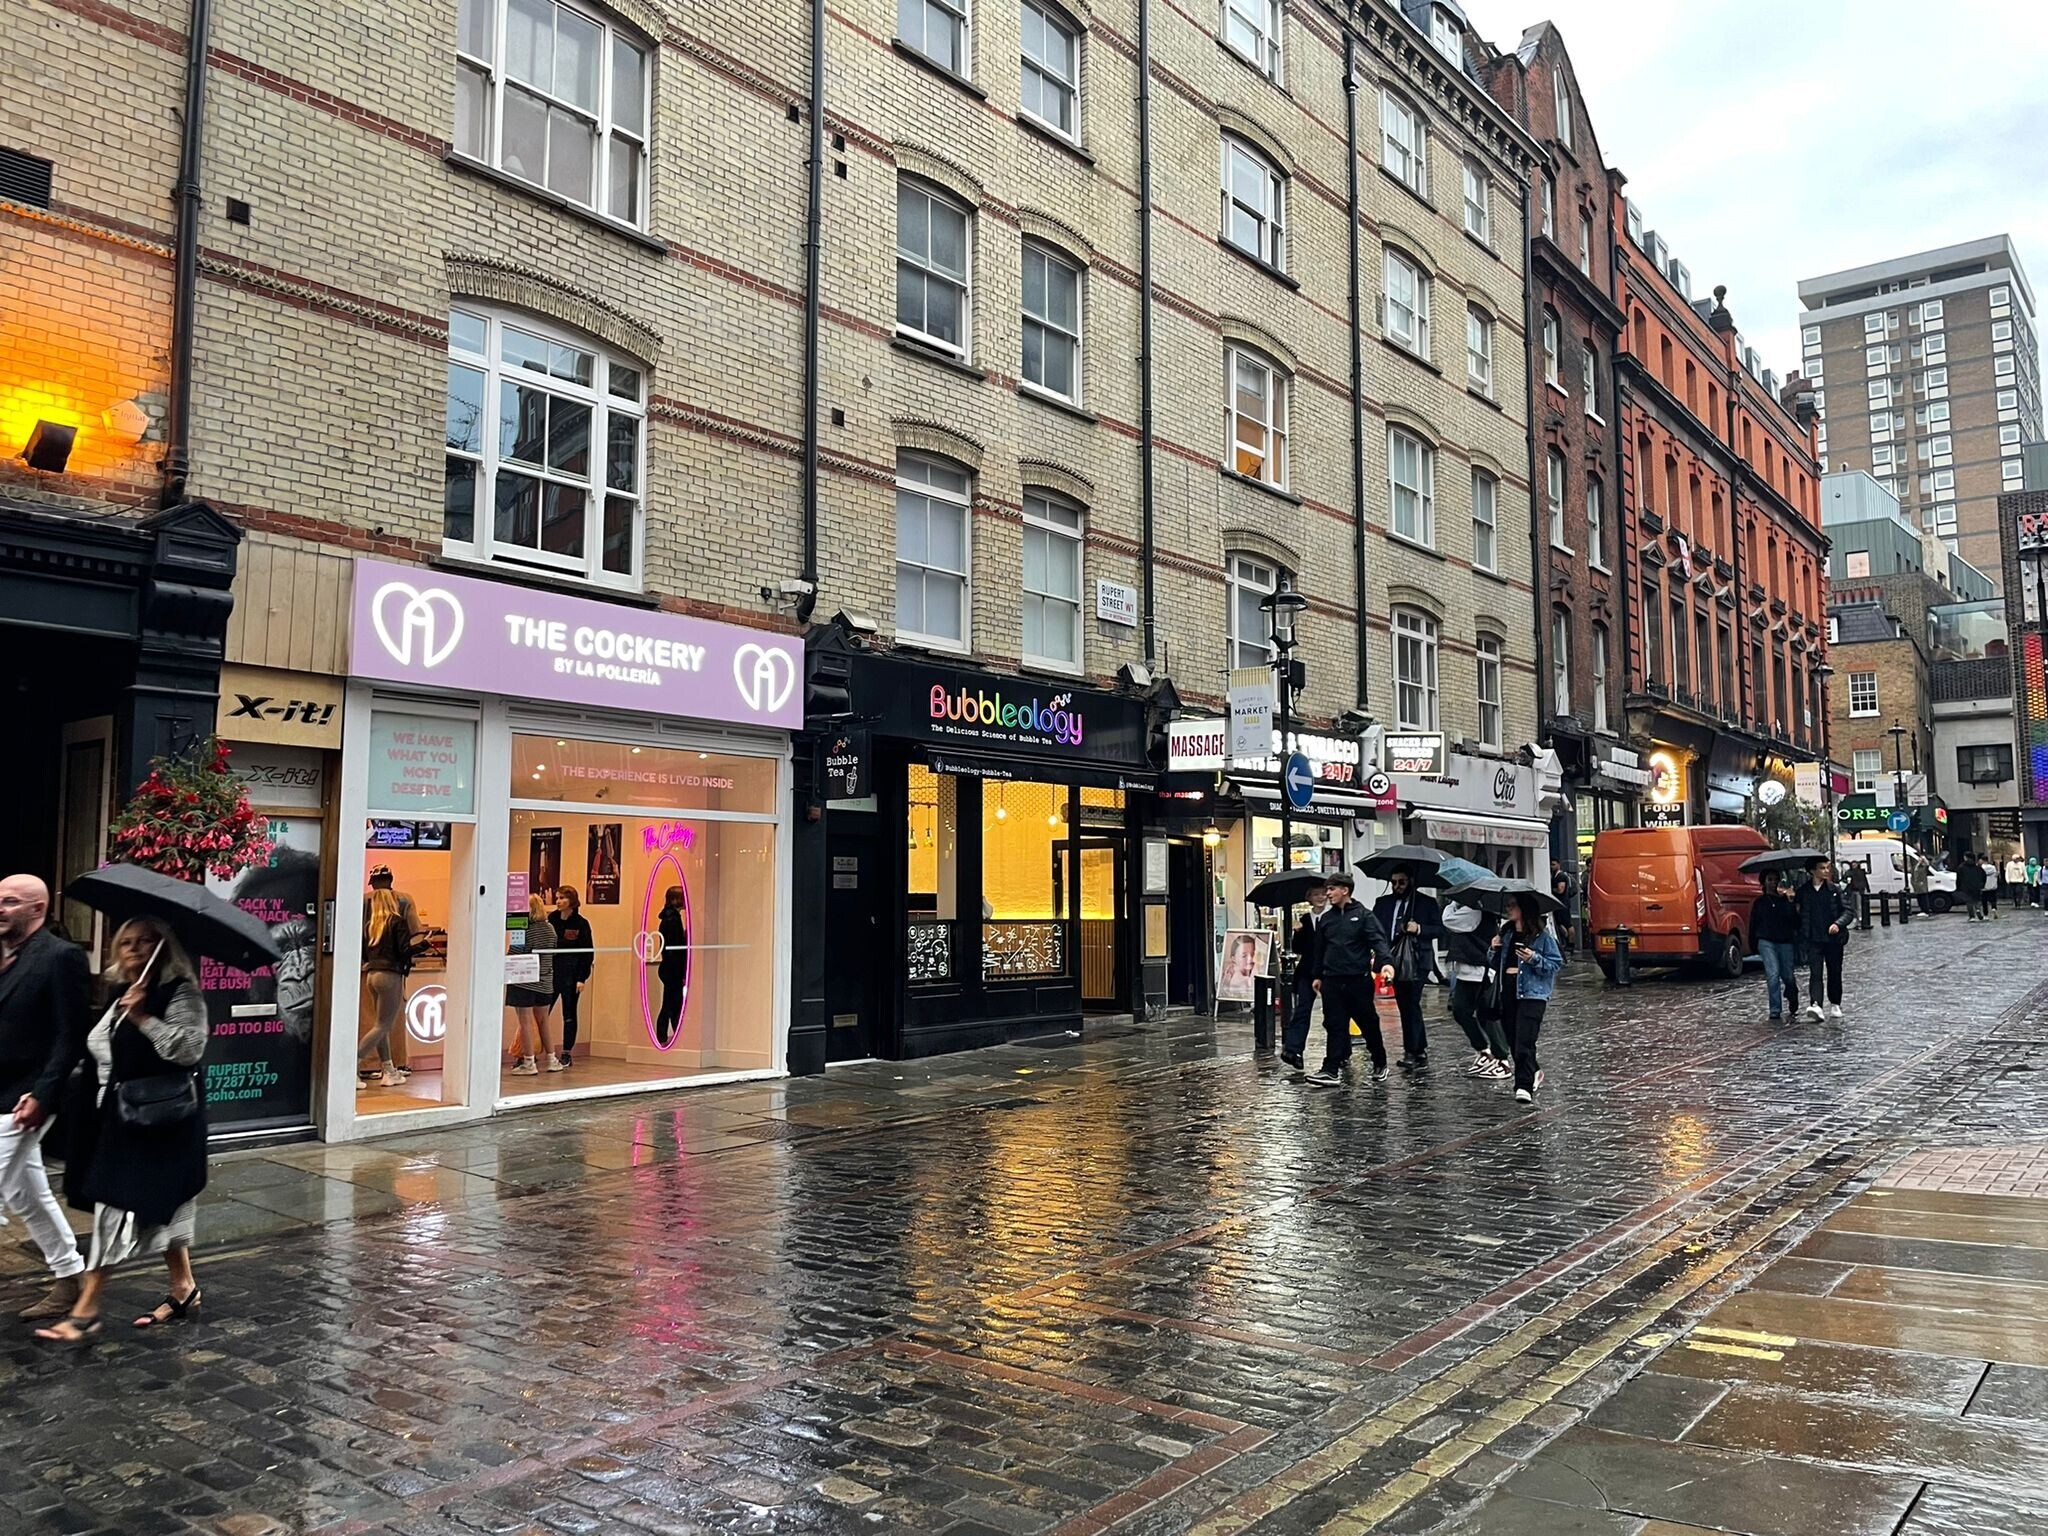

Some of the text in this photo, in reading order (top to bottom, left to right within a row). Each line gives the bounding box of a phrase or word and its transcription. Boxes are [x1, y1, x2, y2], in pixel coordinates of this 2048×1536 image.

[1102, 584, 1124, 599] RUPERT
[1101, 596, 1123, 610] STREET
[504, 614, 706, 672] THE COCKERY
[554, 657, 662, 686] BY LA POLLERÍA
[225, 694, 337, 726] X-it!
[930, 684, 1083, 745] Bubbleology
[1234, 705, 1269, 716] MARKET
[393, 732, 454, 748] WE HAVE
[930, 724, 1052, 745] The Delicious Science of Bubble Tea
[1170, 733, 1224, 758] MASSAGE
[1386, 737, 1441, 748] SNACKS AND
[387, 748, 458, 765] WHAT YOU
[826, 755, 859, 767] Bubble
[1322, 763, 1354, 782] 24/7
[1393, 758, 1433, 772] 24/7
[245, 765, 320, 785] X-it!
[403, 766, 441, 780] MOST
[562, 764, 734, 790] THE EXPERIENCE IS LIVED INSIDE
[828, 768, 845, 778] Tea
[391, 782, 452, 797] DESERVE
[1317, 806, 1335, 815] SWEETS
[1644, 803, 1681, 813] FOOD
[1645, 819, 1681, 828] WINE
[1657, 812, 1668, 820] &
[280, 822, 289, 833] &
[238, 898, 267, 910] SACK
[201, 966, 225, 977] EAT
[219, 977, 252, 989] BUSH
[213, 1021, 284, 1036] JOB TOO BIG
[208, 1061, 268, 1076] RUPERT ST
[215, 1074, 245, 1089] 7287
[248, 1072, 278, 1087] 7979
